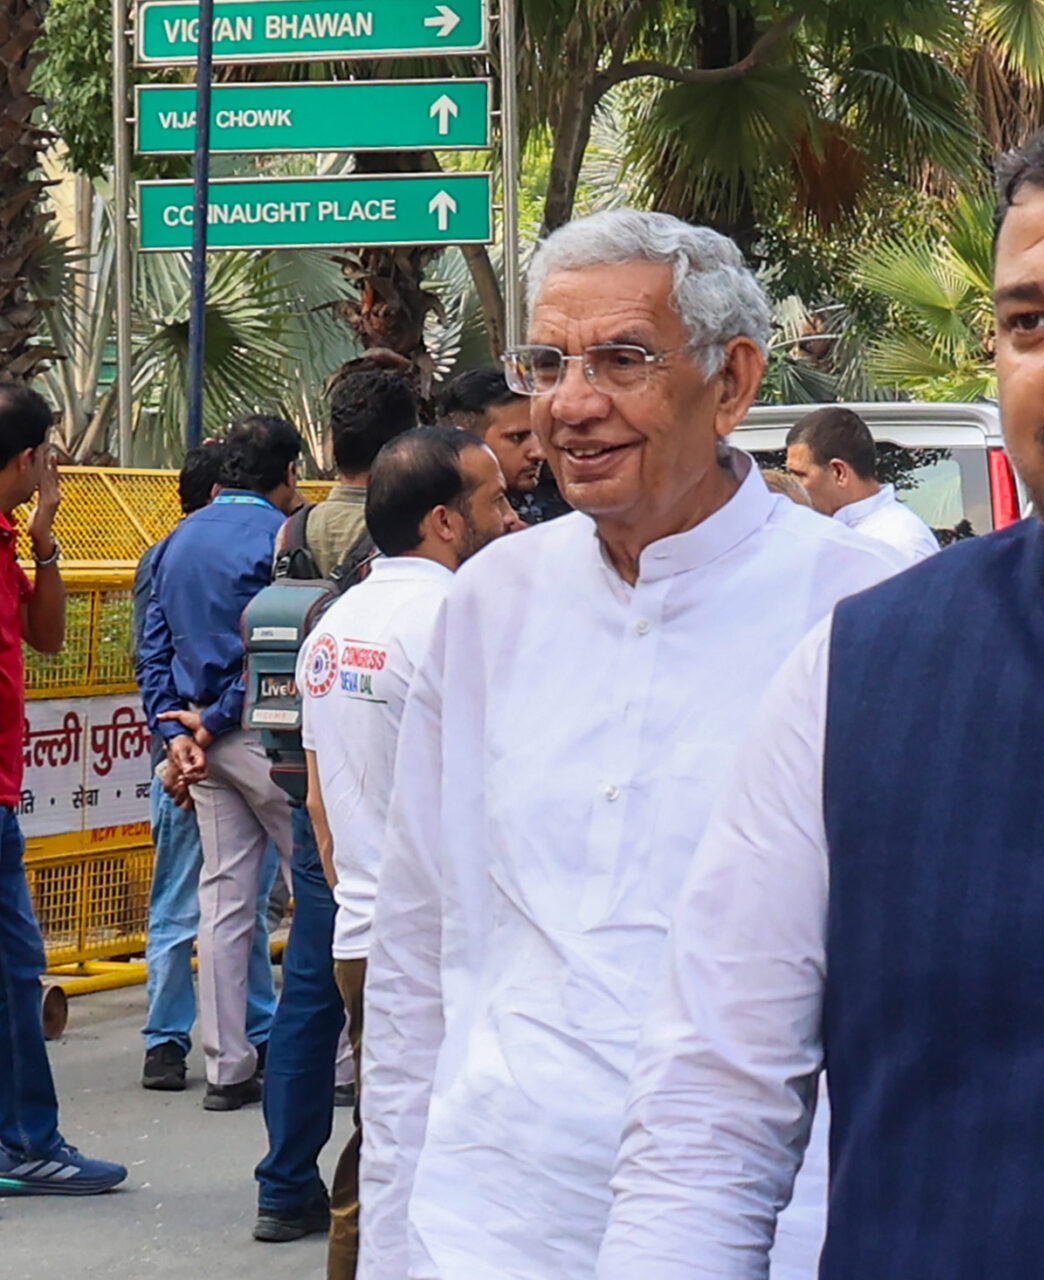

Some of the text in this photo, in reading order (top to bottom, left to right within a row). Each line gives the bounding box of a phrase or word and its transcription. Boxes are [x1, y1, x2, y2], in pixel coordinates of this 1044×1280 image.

[265, 12, 373, 39] BHAWAN
[158, 109, 292, 129] VIJA CHOWK
[318, 200, 397, 221] PLACE
[341, 646, 387, 670] CONGRESS
[261, 678, 297, 697] LiveU
